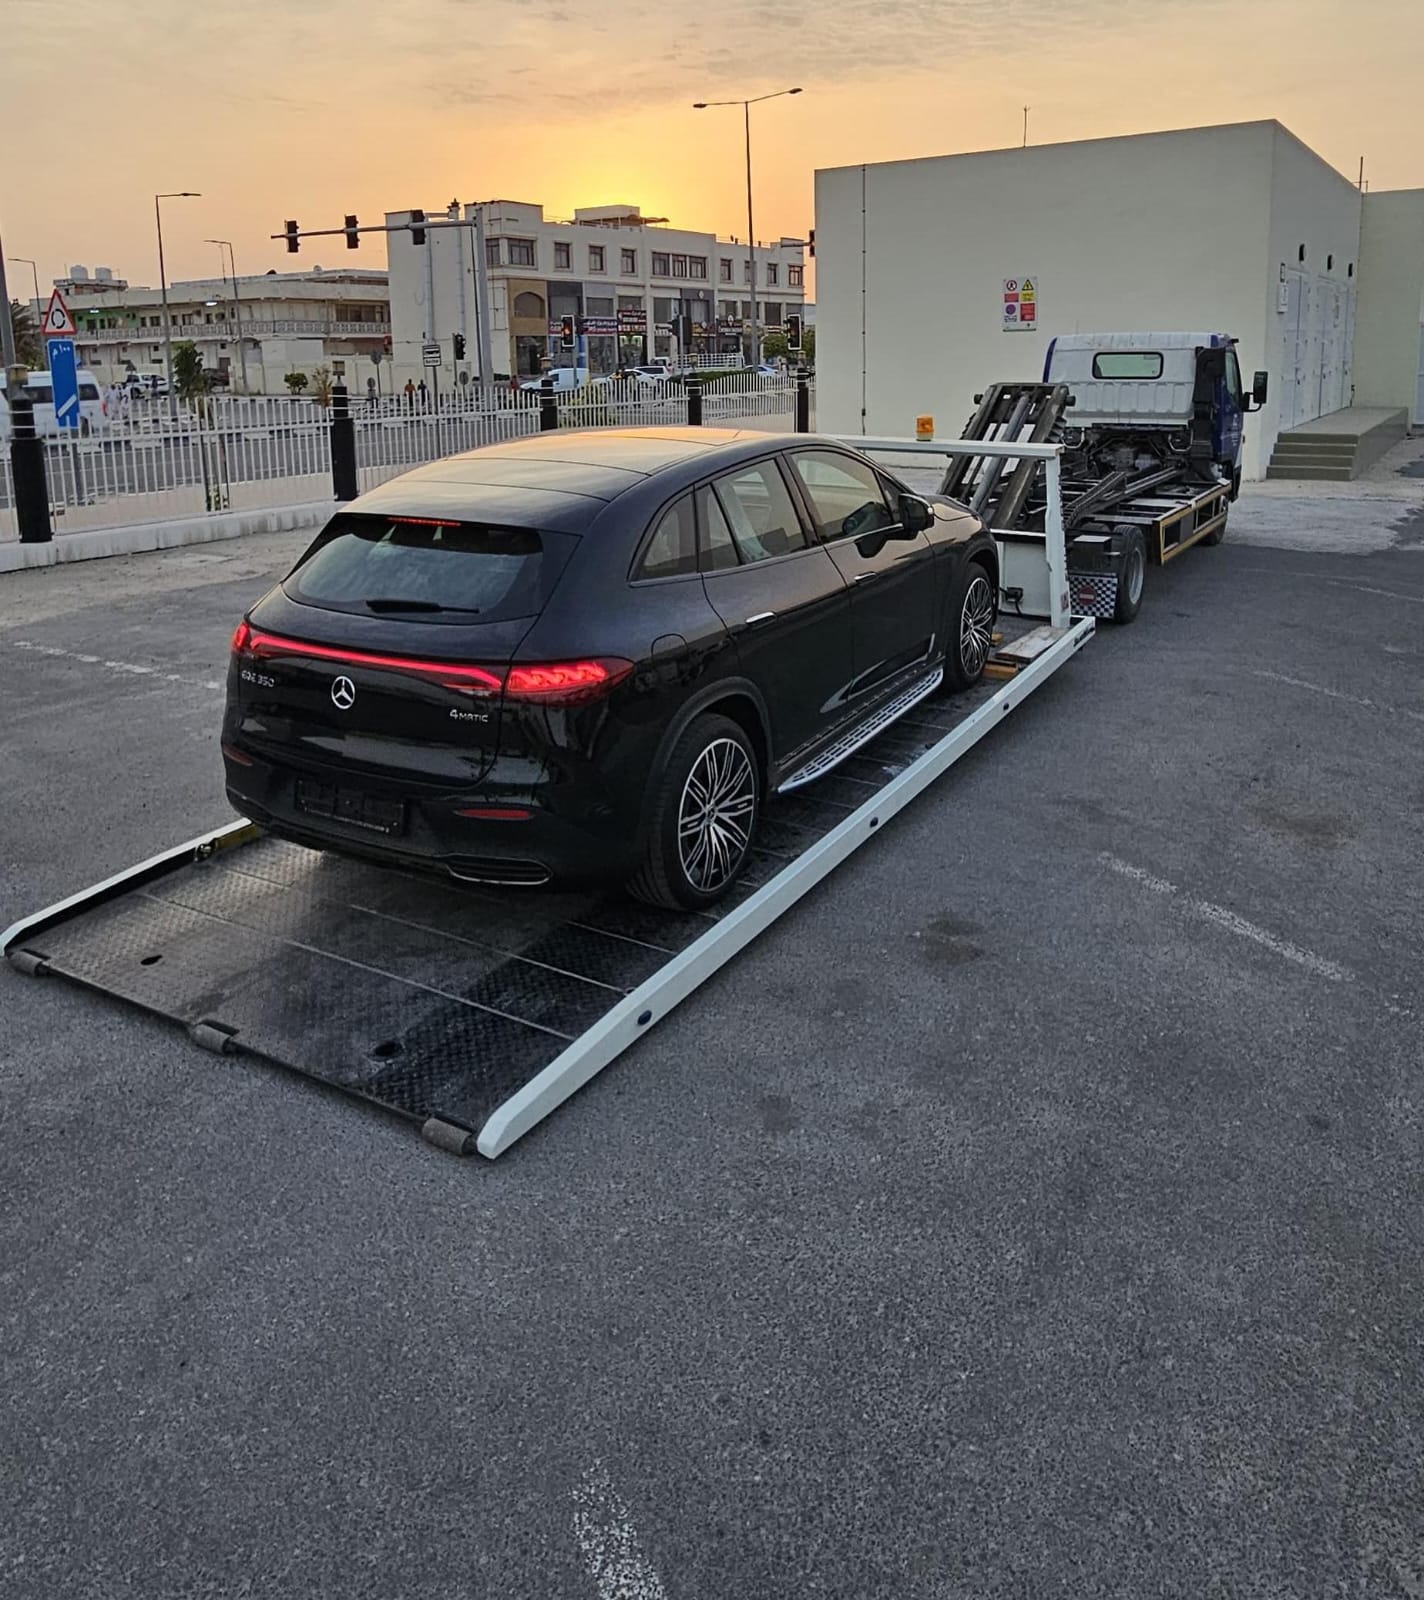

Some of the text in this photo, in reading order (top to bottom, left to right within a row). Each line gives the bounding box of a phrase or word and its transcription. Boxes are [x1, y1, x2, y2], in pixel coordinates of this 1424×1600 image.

[241, 669, 275, 688] EQE 350
[449, 708, 489, 723] 4MATIC
